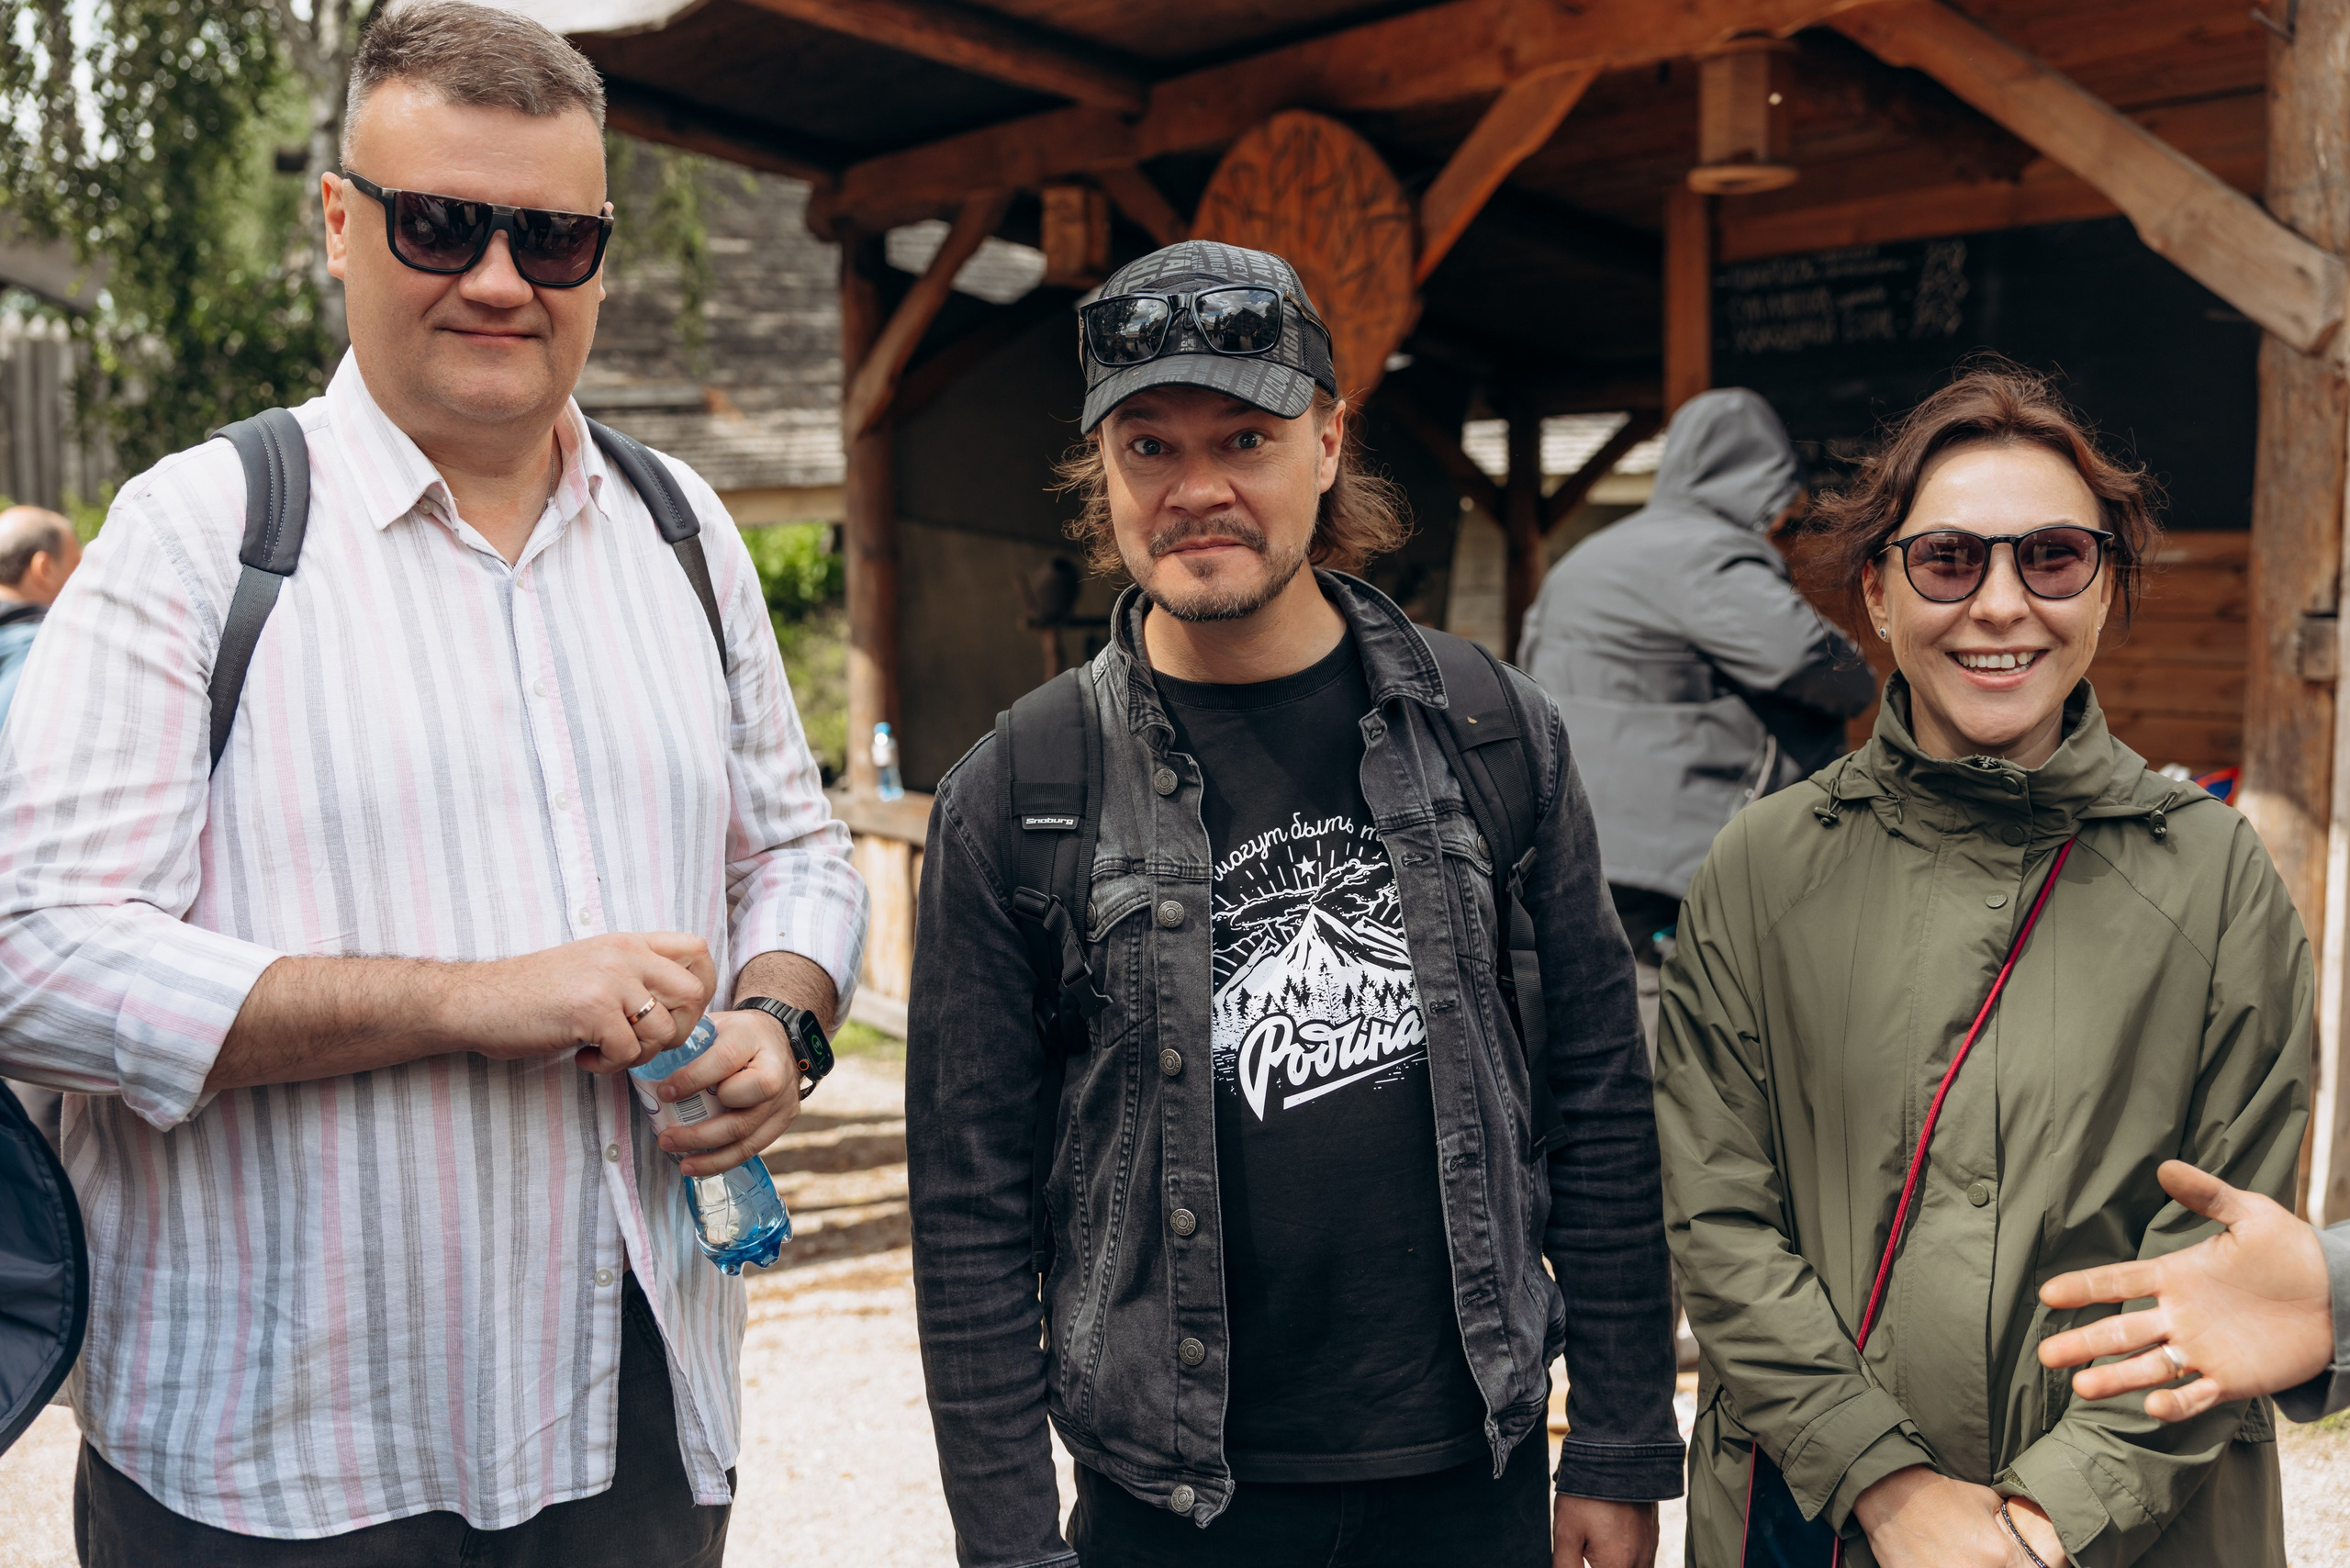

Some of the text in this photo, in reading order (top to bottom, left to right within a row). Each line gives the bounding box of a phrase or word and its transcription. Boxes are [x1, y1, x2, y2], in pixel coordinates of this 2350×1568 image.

[1025, 817, 1074, 825] Snoburg
[1214, 826, 1289, 882] могут
[1290, 812, 1355, 840] быть
[1238, 1009, 1427, 1122] Родина
